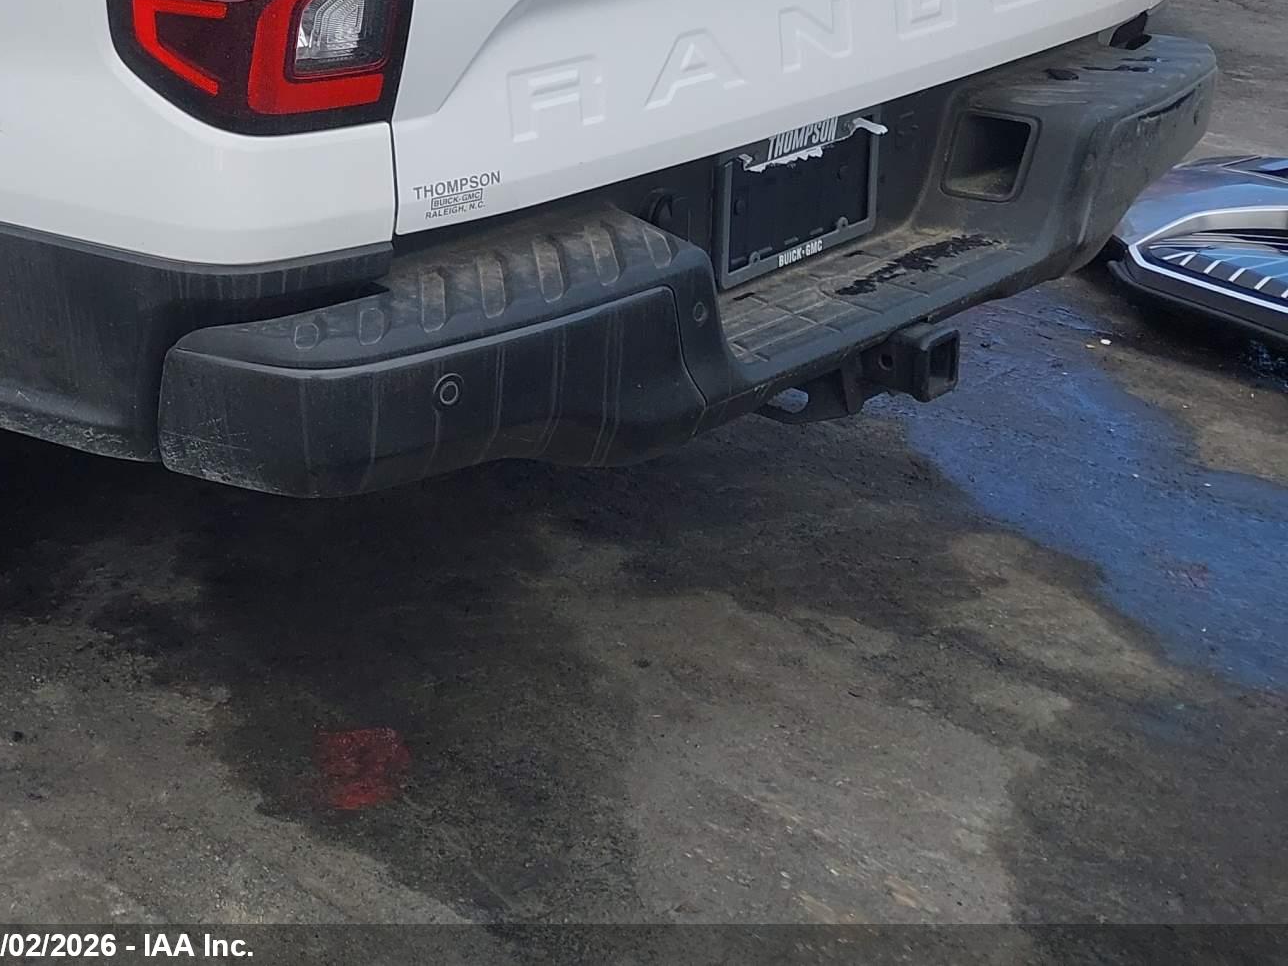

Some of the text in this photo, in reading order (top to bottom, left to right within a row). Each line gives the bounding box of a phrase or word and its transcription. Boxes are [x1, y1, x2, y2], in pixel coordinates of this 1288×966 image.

[767, 116, 839, 161] THOMPSON
[413, 170, 501, 200] THOMPSON
[433, 191, 481, 208] BUICK-GMC
[469, 200, 486, 211] N.C.
